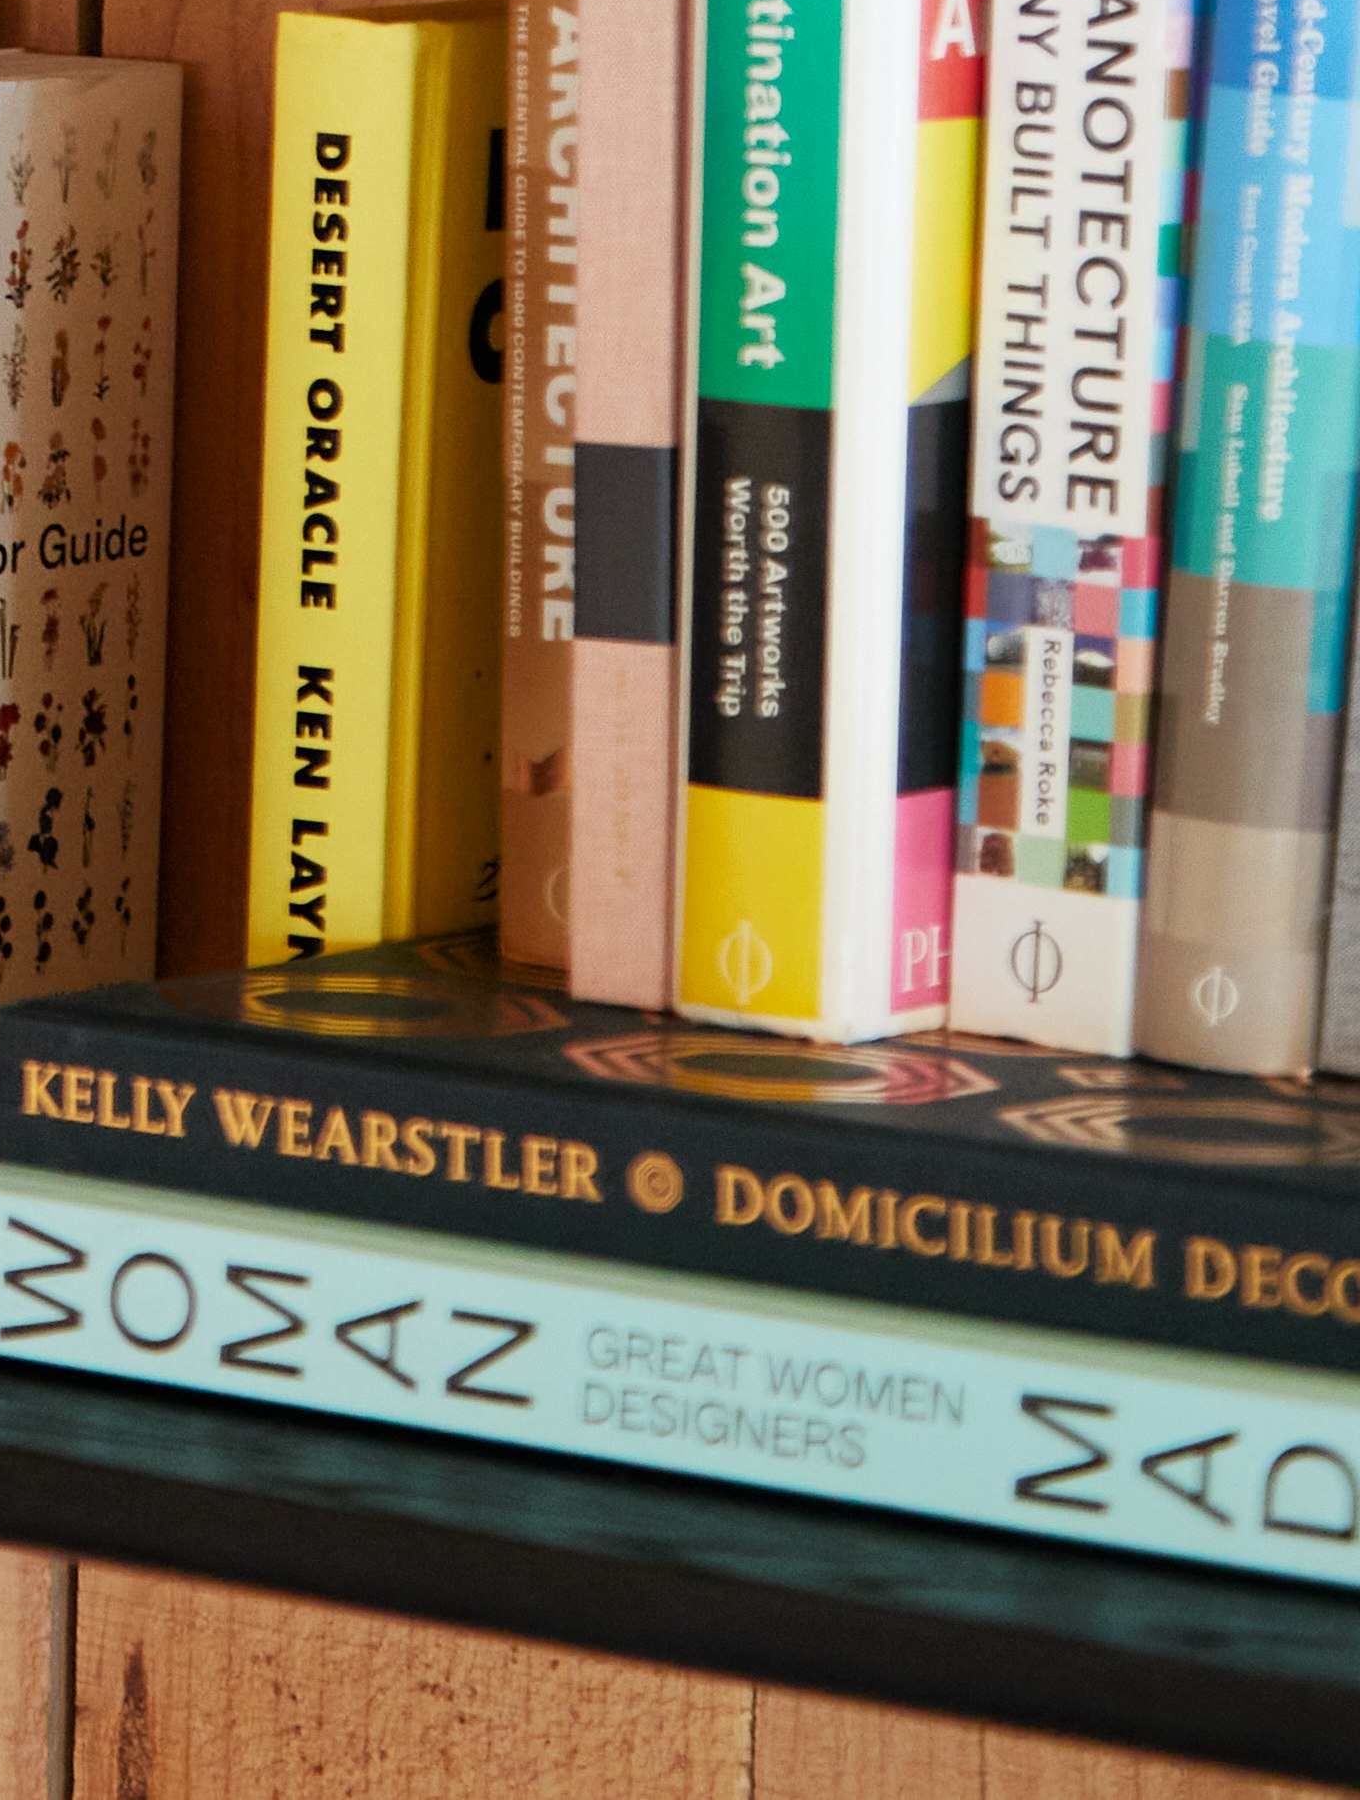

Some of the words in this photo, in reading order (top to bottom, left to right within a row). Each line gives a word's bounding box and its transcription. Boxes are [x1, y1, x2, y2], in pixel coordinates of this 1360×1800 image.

[516, 3, 530, 41] THE
[514, 50, 528, 168] ESSENTIAL
[1249, 61, 1277, 157] Guide
[514, 175, 527, 239] GUIDE
[1008, 82, 1058, 251] BUILT
[310, 133, 350, 353] DESERT
[513, 247, 527, 275] TO
[1277, 175, 1312, 299] Modern
[737, 264, 786, 369] Art
[511, 333, 526, 514] CONTEMPORARY
[998, 277, 1049, 505] THINGS
[1261, 310, 1299, 522] Architecture
[40, 514, 147, 570] Guide
[301, 379, 343, 610] ORACLE
[725, 477, 752, 583] Worth
[764, 484, 790, 553] 500
[508, 521, 524, 638] BUILDINGS
[723, 588, 749, 645] the
[717, 653, 746, 717] Trip
[756, 557, 788, 718] Artworks
[292, 665, 335, 791] KEN
[1037, 638, 1061, 753] Rebecca
[1035, 761, 1058, 827] Roke
[21, 1061, 194, 1138] KELLY
[215, 1087, 603, 1203] WEARSTLER
[715, 1165, 1155, 1289] DOMICILIUM
[583, 1382, 867, 1470] DESIGNERS
[586, 1326, 750, 1390] GREAT
[767, 1353, 967, 1426] WOMEN
